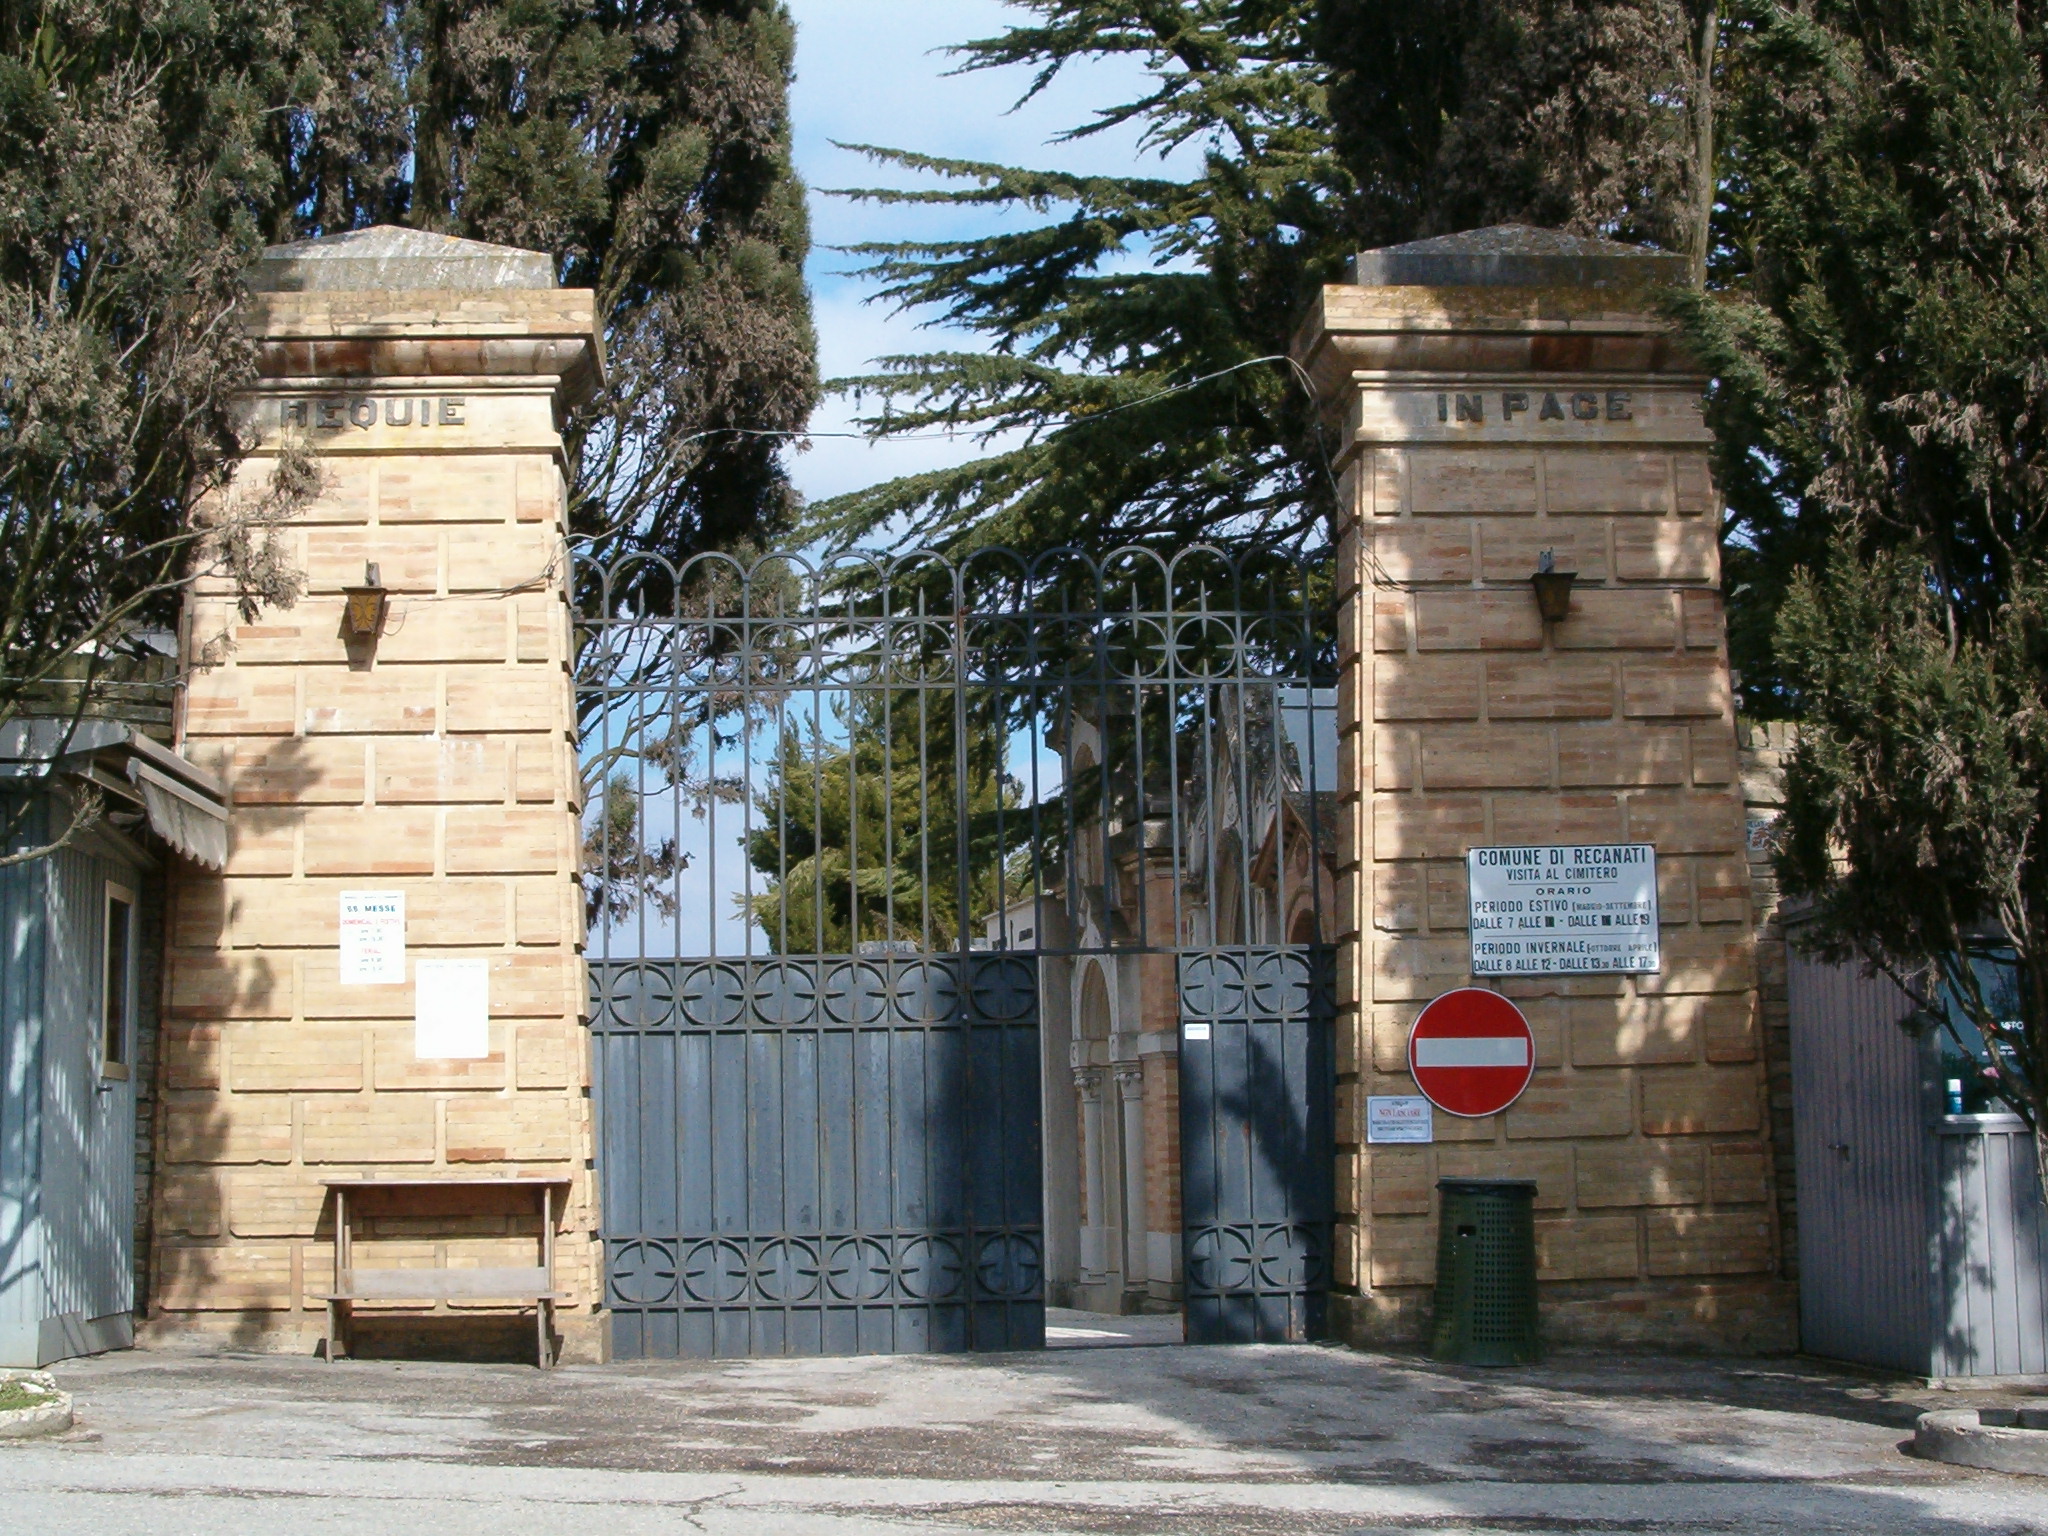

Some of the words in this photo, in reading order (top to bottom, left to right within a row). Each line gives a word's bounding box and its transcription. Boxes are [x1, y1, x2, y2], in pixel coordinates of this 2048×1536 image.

[281, 397, 466, 430] REQUIE
[1438, 393, 1484, 422] IN
[1502, 391, 1633, 421] PACE
[1478, 849, 1542, 866] COMUNE
[1550, 849, 1564, 865] DI
[1574, 847, 1646, 864] RECANATI
[1506, 868, 1541, 881] VISITA
[1546, 868, 1559, 880] AL
[1565, 866, 1618, 880] CIMITERO
[1535, 886, 1592, 896] ORARIO
[364, 904, 397, 913] MESSE
[1474, 900, 1523, 914] PERIODO
[1528, 899, 1569, 913] ESTIVO
[1472, 916, 1503, 930] DALLE
[1507, 916, 1514, 929] 7
[1518, 915, 1542, 929] ALLE
[1568, 914, 1598, 928] DALLE
[1615, 913, 1639, 927] ALLE
[1474, 942, 1521, 956] PERIODO
[1526, 940, 1586, 955] INVERNALE
[1473, 959, 1503, 972] DALLE
[1505, 960, 1513, 971] 8
[1515, 958, 1539, 971] ALLE
[1541, 957, 1552, 971] 12
[1559, 956, 1590, 971] DALLE
[1612, 956, 1636, 969] ALLE
